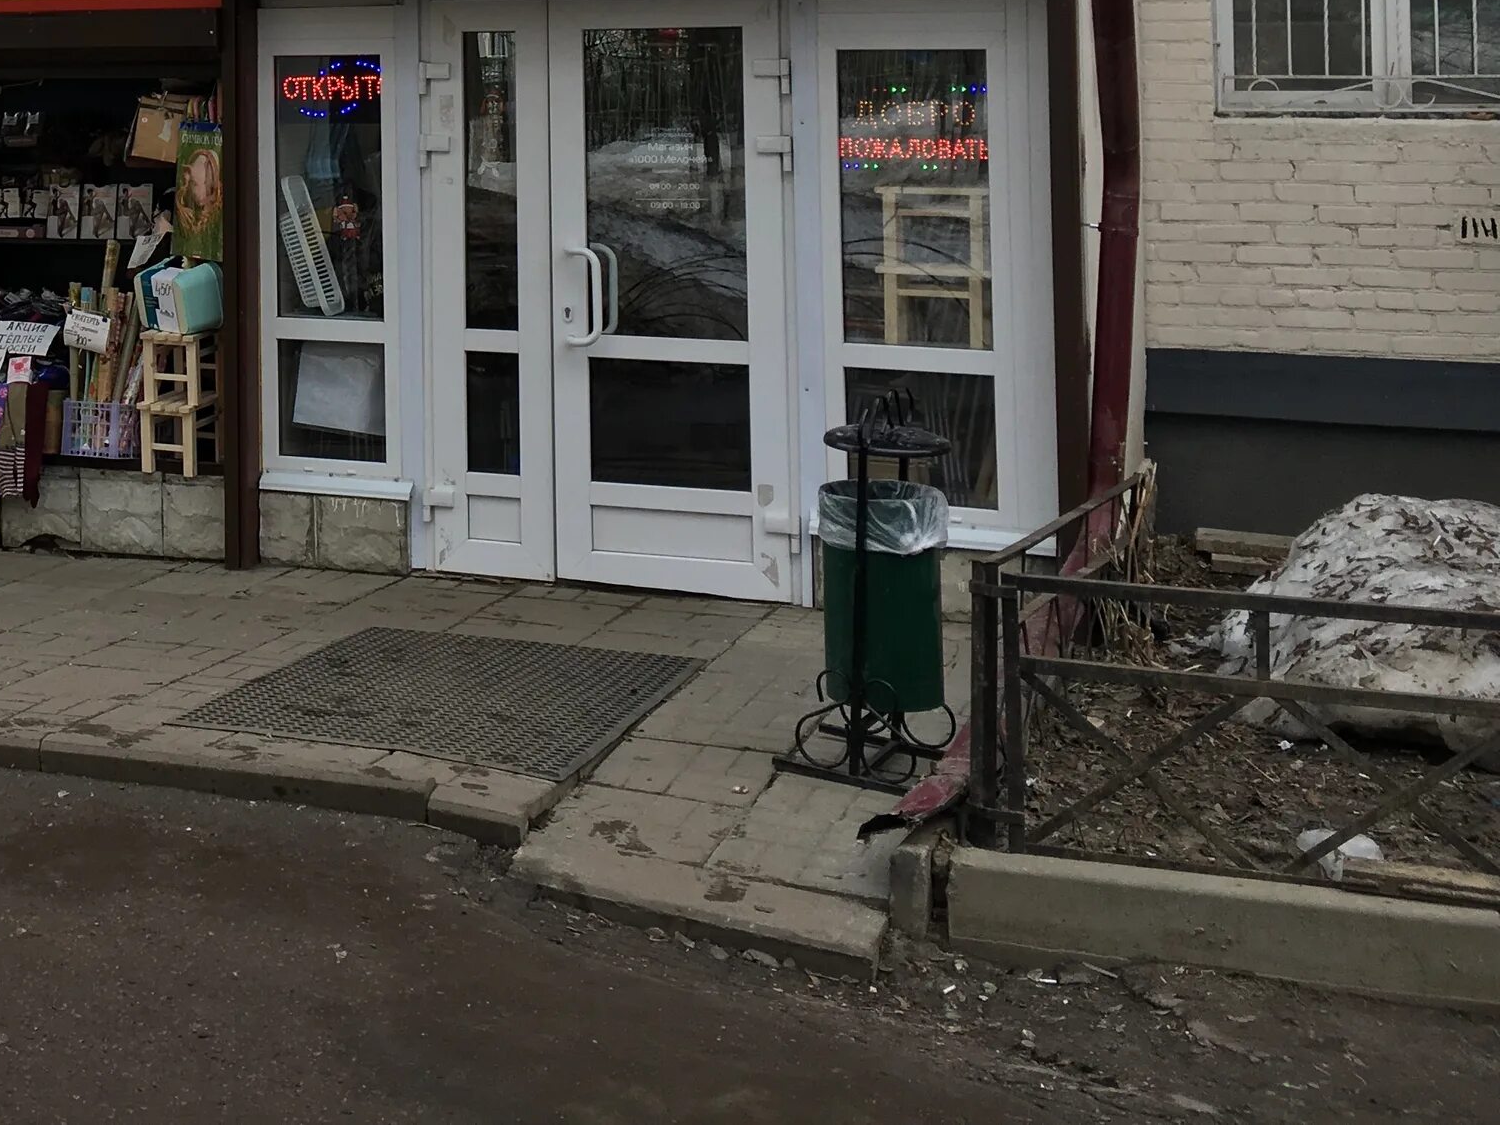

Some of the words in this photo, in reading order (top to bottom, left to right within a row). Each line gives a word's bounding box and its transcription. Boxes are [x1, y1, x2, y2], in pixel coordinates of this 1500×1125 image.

[282, 75, 381, 101] ОТКРЫТ
[852, 99, 977, 129] ДОБРО
[839, 137, 989, 161] ПОЖАЛОВАТЬ
